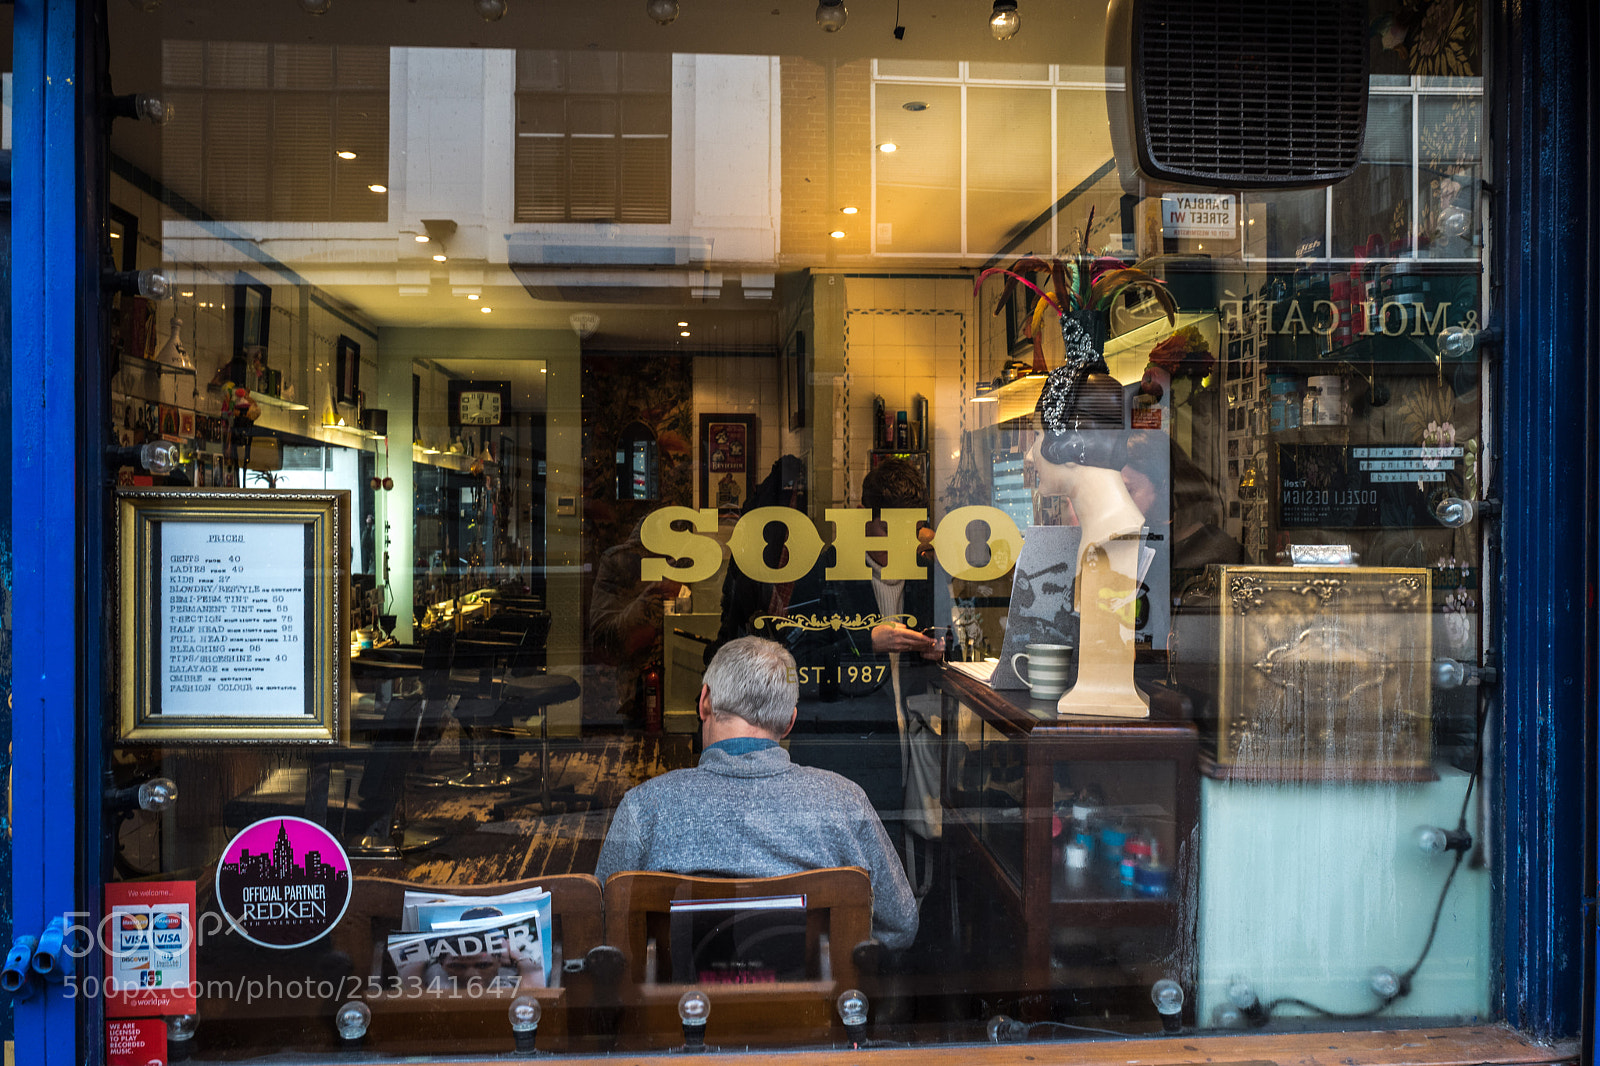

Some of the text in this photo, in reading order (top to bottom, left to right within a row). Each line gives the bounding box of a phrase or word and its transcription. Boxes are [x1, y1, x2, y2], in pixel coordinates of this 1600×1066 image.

[208, 534, 245, 543] PRICES
[640, 504, 1024, 583] SOHO
[170, 554, 200, 563] GENTS
[170, 565, 206, 573] LADIES
[170, 575, 194, 583] KIDS
[170, 595, 222, 603] SEMI-PERM
[225, 595, 249, 603] TINT
[170, 605, 227, 613] PERMANENT
[231, 605, 254, 613] TINT
[170, 615, 222, 623] T-SECTION
[169, 625, 195, 633] HALF
[198, 625, 225, 633] HEAD
[170, 635, 196, 643] FULL
[170, 645, 226, 653] BLEACHING
[169, 664, 218, 673] BALAYAGE
[170, 674, 203, 682] OMBRE
[170, 684, 211, 692] FASHION
[218, 684, 253, 692] COLOUR
[242, 884, 326, 903] OFFICIAL PARTNER
[243, 901, 326, 920] REDKEN
[124, 933, 181, 945] VISA VISA
[389, 924, 541, 966] FADER
[137, 998, 170, 1007] worldpay
